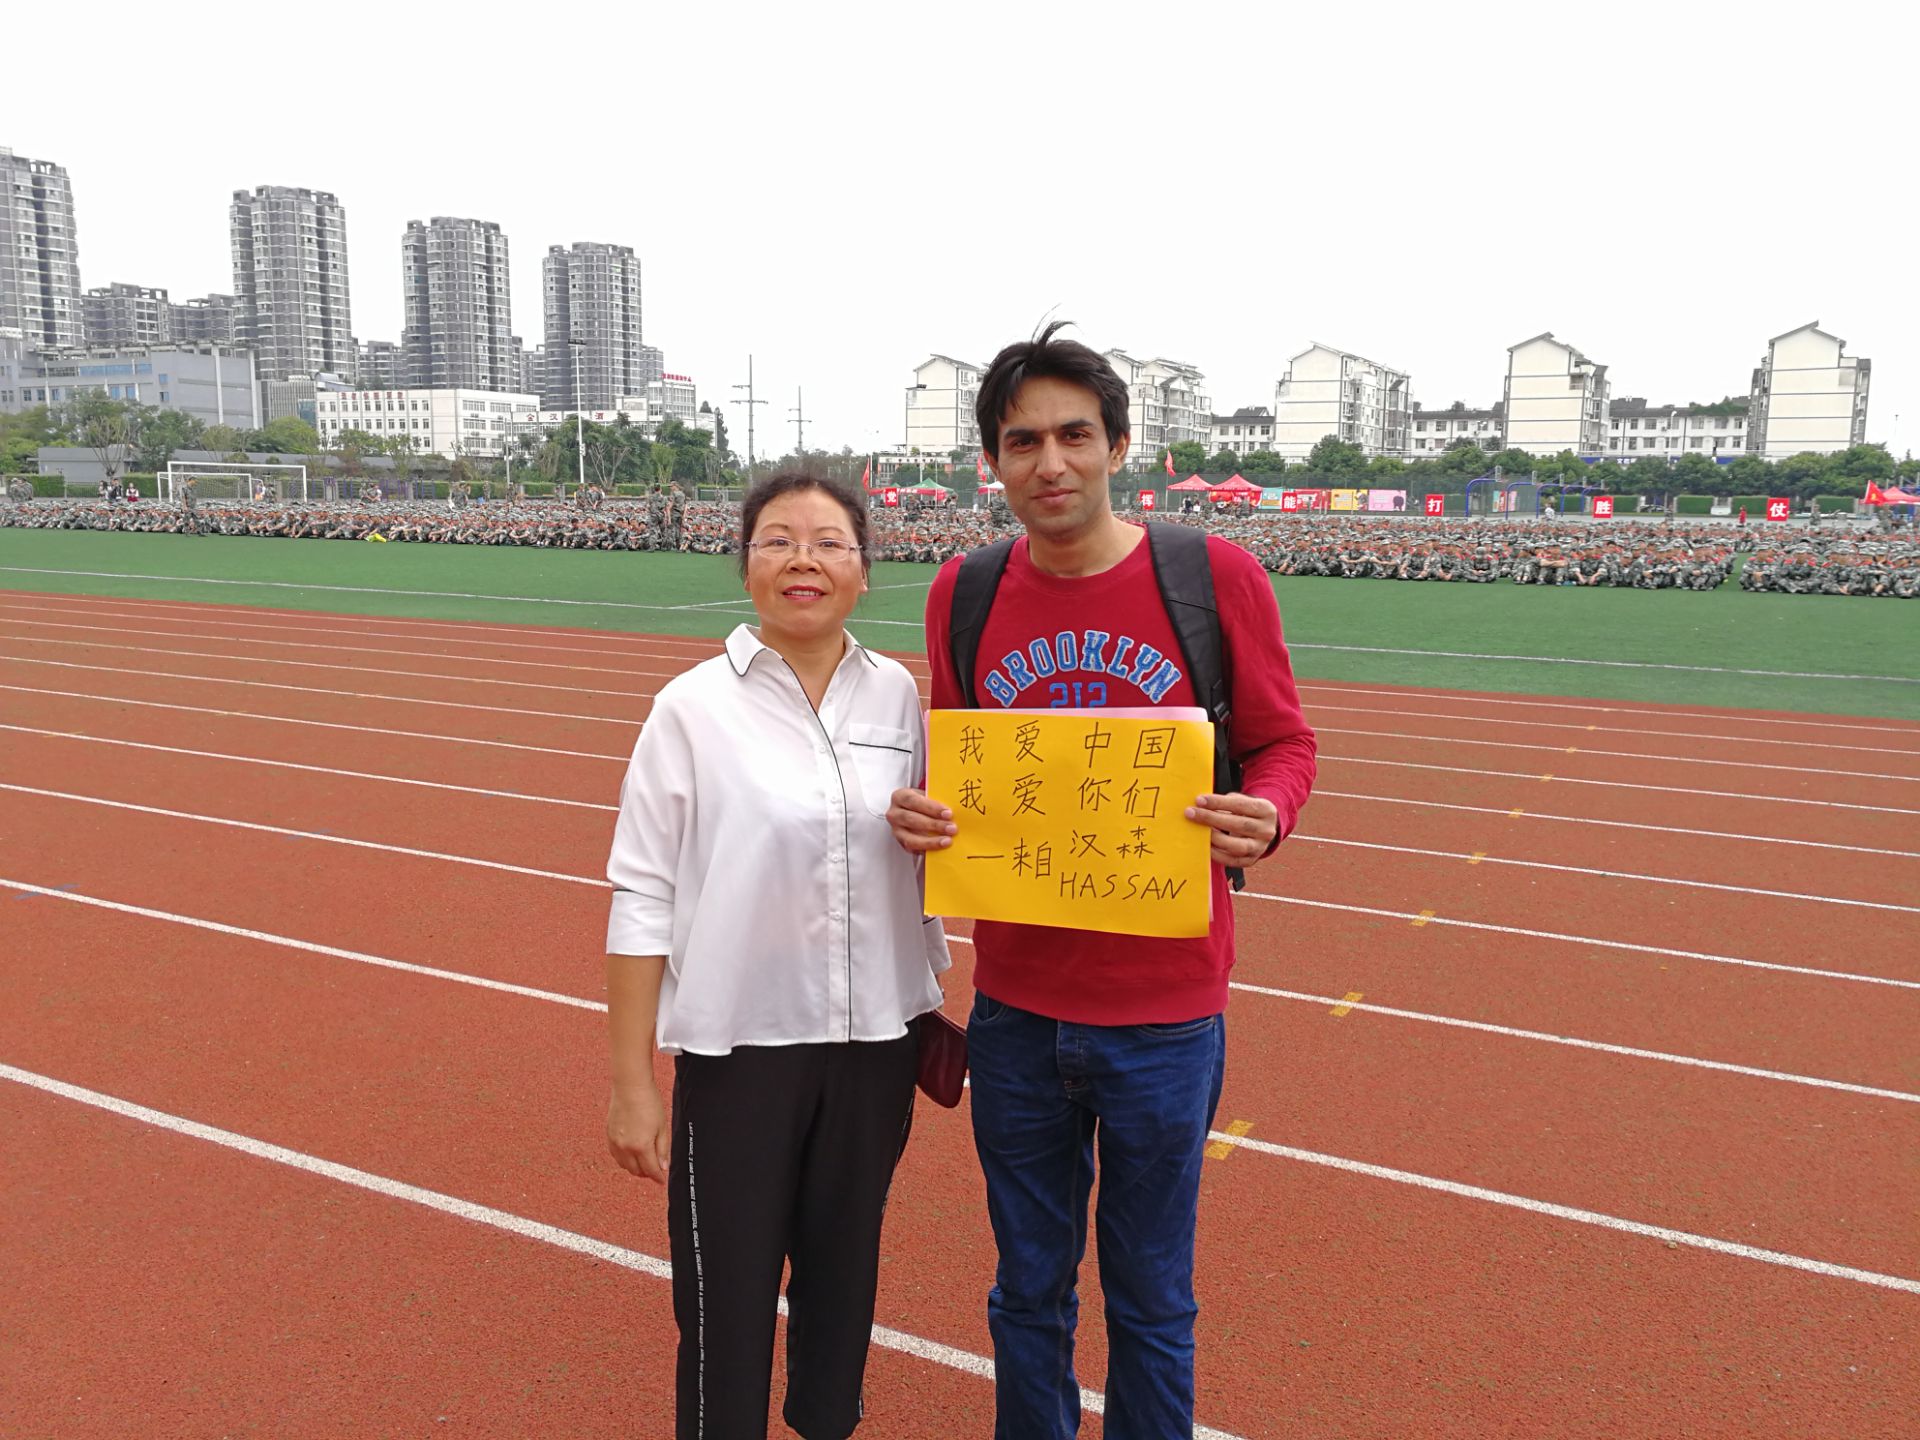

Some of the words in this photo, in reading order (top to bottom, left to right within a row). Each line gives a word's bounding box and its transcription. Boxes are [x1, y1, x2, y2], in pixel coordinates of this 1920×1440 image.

[1283, 495, 1297, 509] 能
[1427, 498, 1442, 512] 打
[1595, 501, 1612, 514] 胜
[1769, 502, 1787, 517] 仗
[984, 630, 1182, 707] BROOKLYN
[1050, 682, 1107, 708] 212
[959, 720, 1176, 769] 我爱中国
[958, 773, 1160, 818] 我爱你们
[1060, 872, 1187, 900] HASSAN
